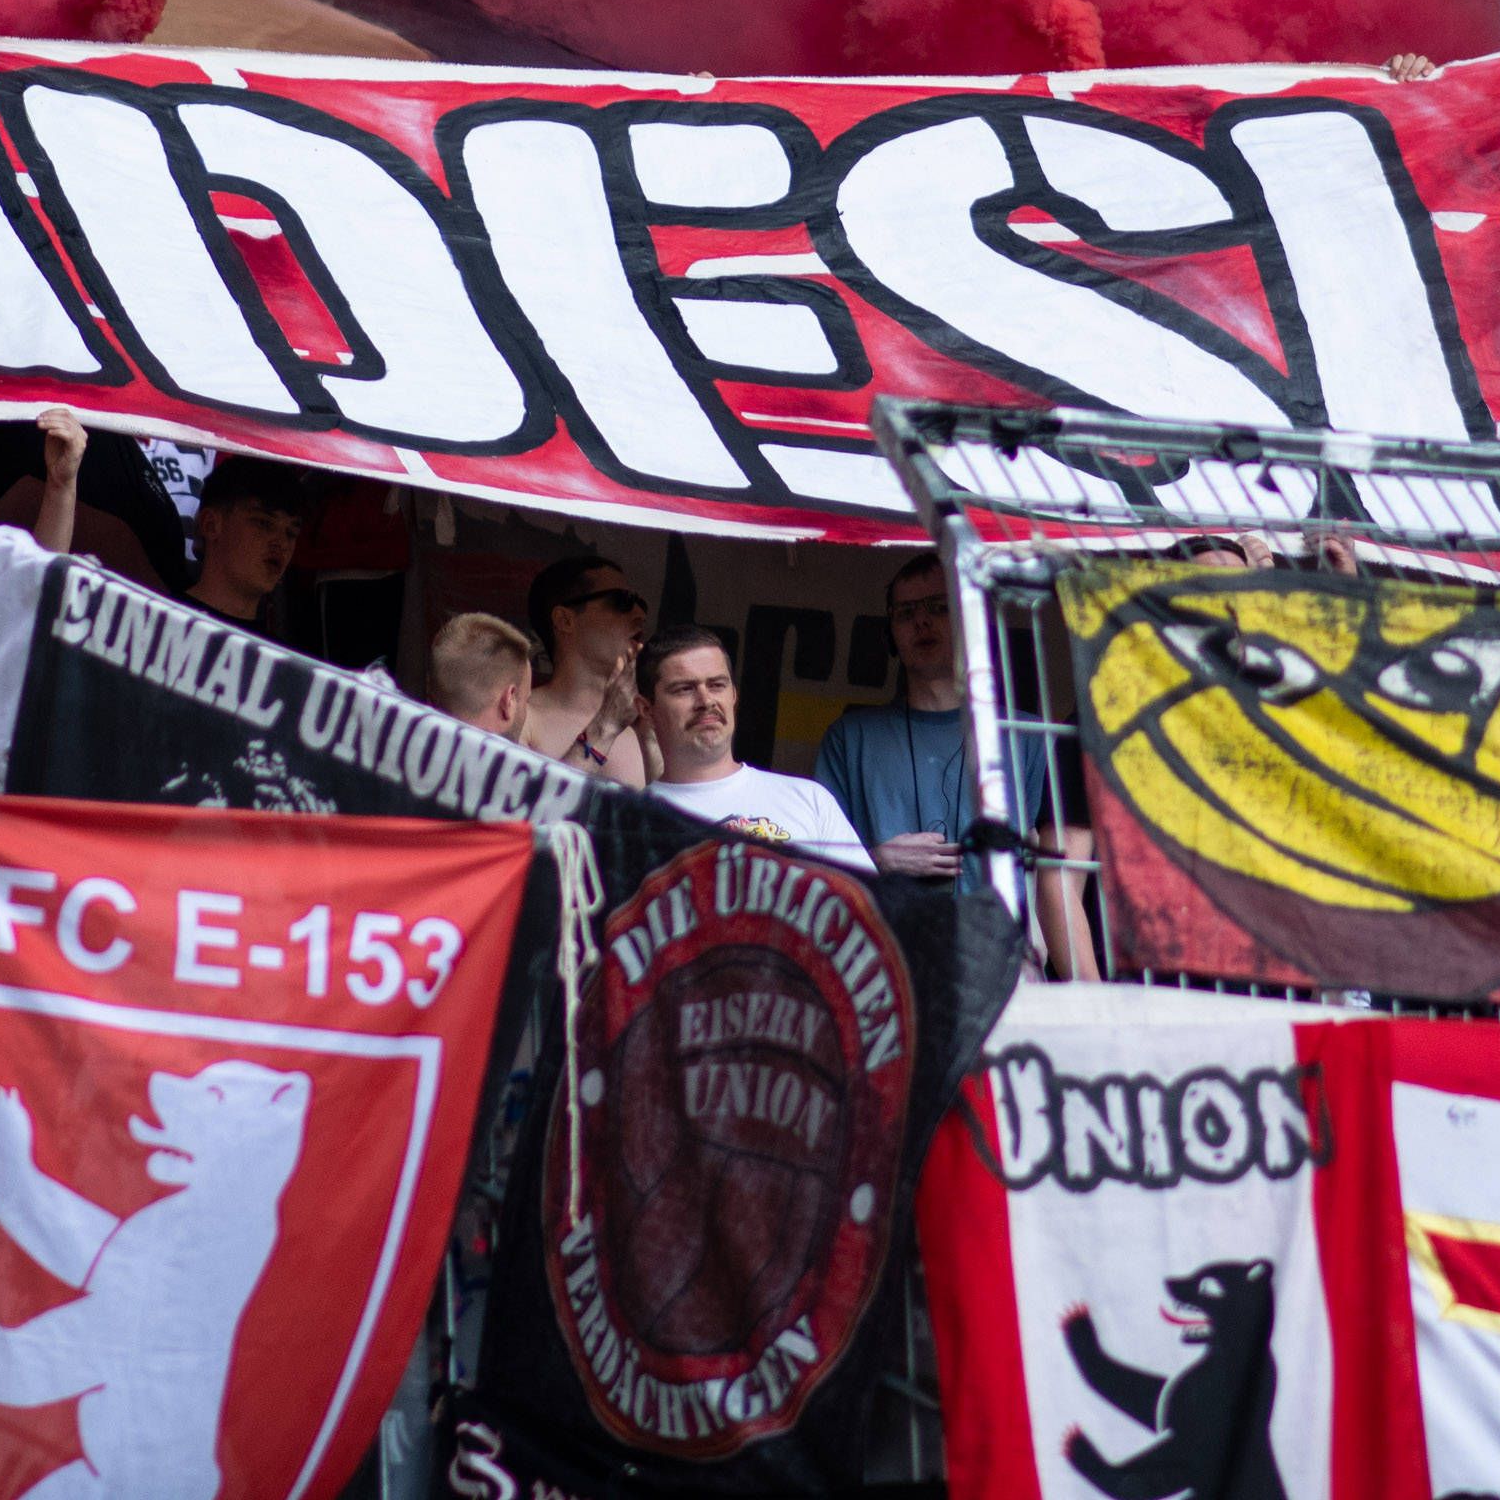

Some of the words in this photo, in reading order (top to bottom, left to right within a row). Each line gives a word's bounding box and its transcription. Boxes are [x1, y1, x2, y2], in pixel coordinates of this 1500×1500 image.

[52, 564, 292, 730] EINMAL
[299, 666, 590, 830] UNIONER
[174, 889, 463, 1009] E-153
[611, 875, 699, 986] DIE
[714, 842, 902, 1074] ÜBLICHEN
[678, 992, 830, 1055] EISERN
[684, 1061, 837, 1150] UNION
[561, 1212, 820, 1440] VERDÄCHTIGEN
